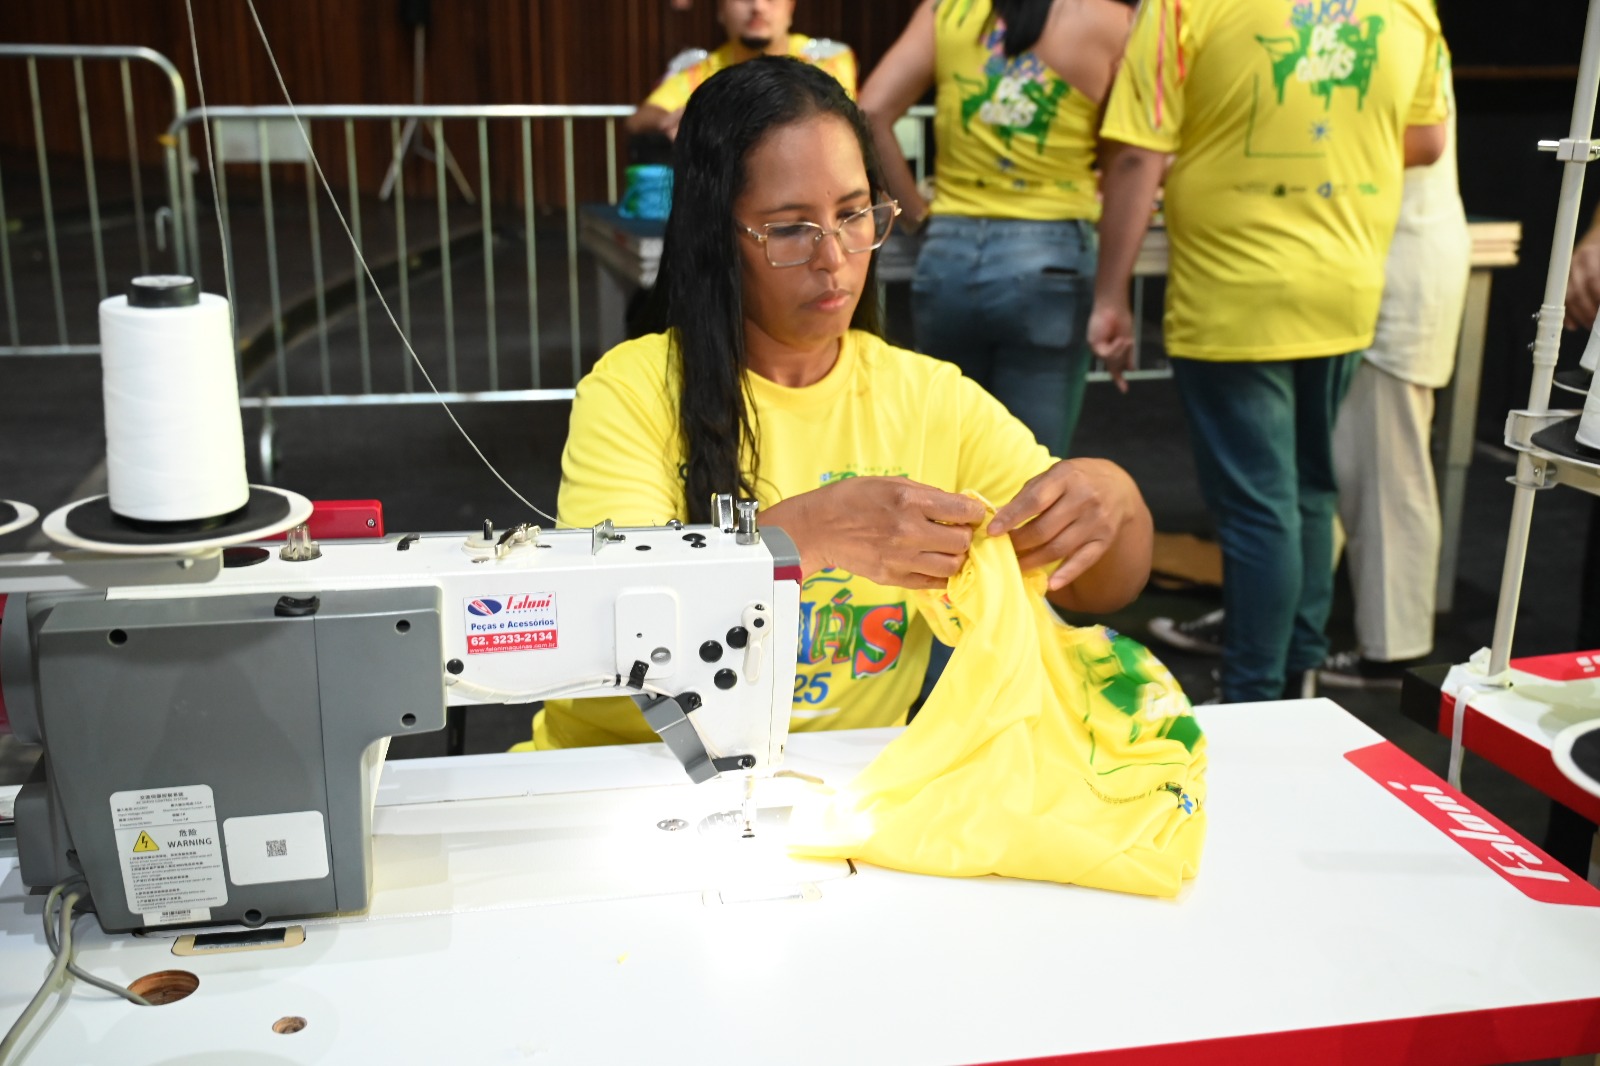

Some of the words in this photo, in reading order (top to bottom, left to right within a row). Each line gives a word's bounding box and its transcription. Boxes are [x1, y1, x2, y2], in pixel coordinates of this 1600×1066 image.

[471, 622, 497, 631] Peças
[507, 618, 555, 629] Acessórios
[471, 636, 489, 646] 62.
[493, 631, 553, 645] 3233-2134
[797, 588, 906, 679] IÁS
[179, 828, 197, 838] 危险
[1387, 781, 1570, 883] Faloni
[167, 837, 213, 848] WARNING
